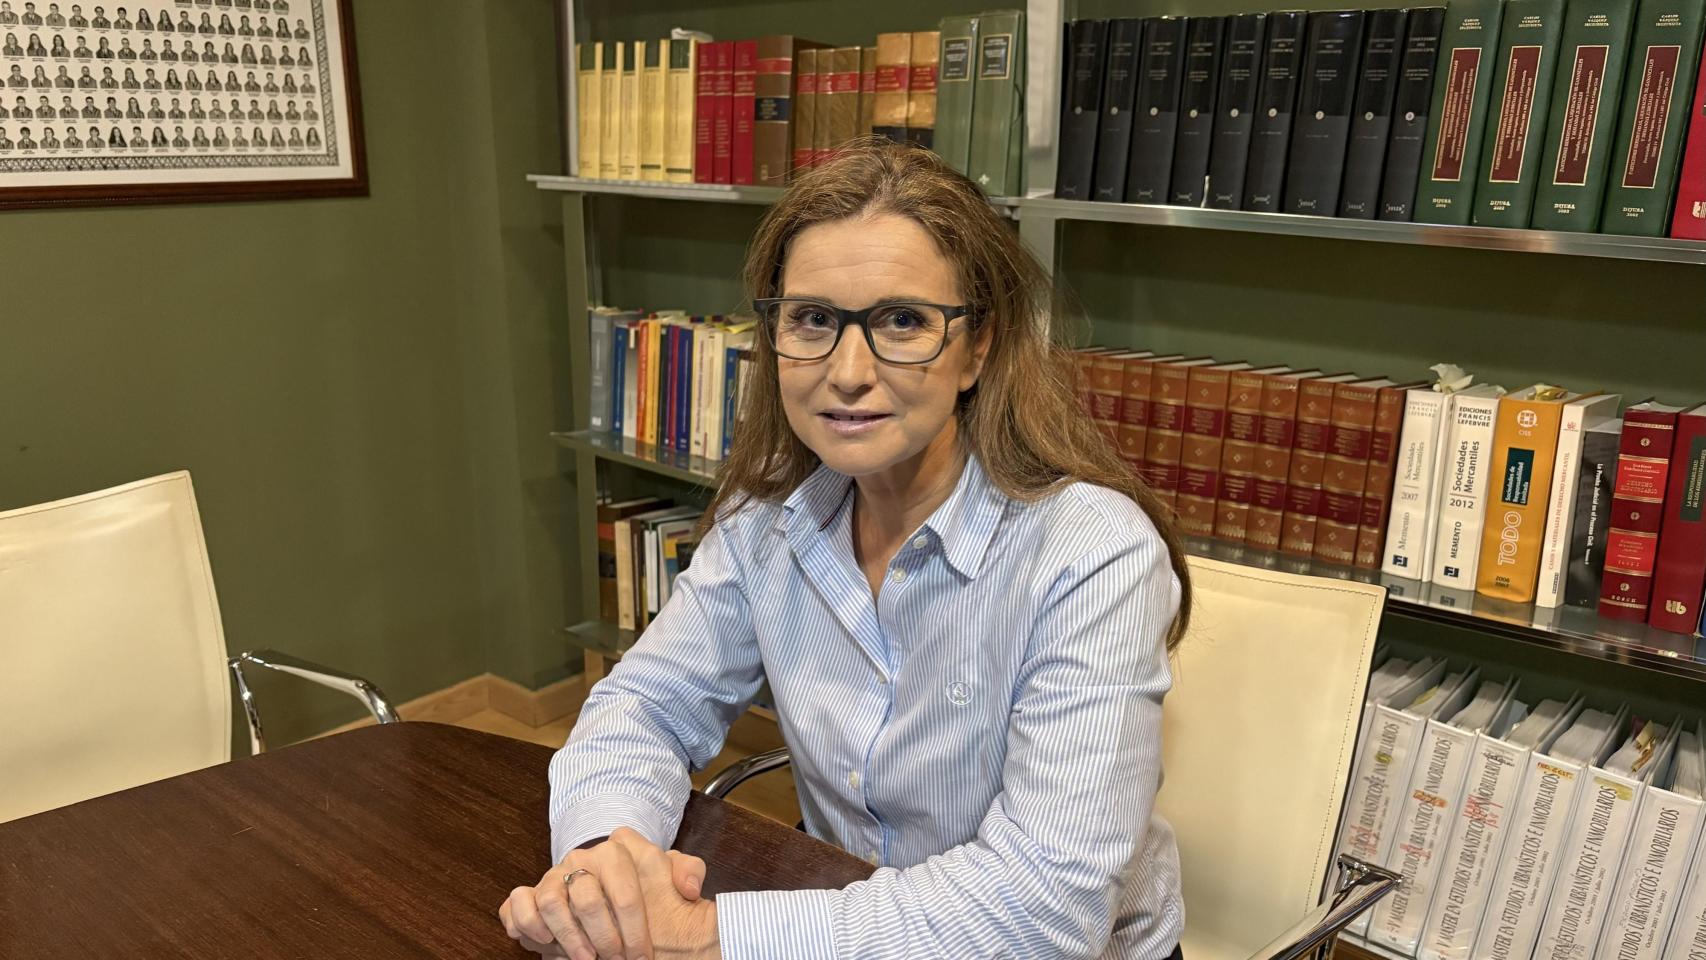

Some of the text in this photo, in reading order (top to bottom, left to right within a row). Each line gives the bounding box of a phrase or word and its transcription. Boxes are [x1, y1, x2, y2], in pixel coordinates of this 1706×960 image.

[1457, 419, 1490, 428] LEFEBVRE
[1458, 412, 1491, 421] FRANCIS
[1460, 406, 1492, 415] EDICIONES
[1406, 442, 1416, 480] Sociedades
[1453, 440, 1468, 492] Sociedades
[1464, 441, 1480, 492] Mercantiles
[1401, 492, 1418, 501] 2007
[1450, 500, 1474, 509] 2012
[1551, 516, 1560, 547] MATERIALES
[1556, 483, 1565, 507] DERECHO
[1398, 512, 1410, 550] Memento
[1451, 521, 1462, 558] MEMENTO
[1498, 511, 1522, 566] TODO
[1527, 769, 1560, 830] INMOBILIARIOS
[1584, 783, 1618, 846] INMOBILIARIOS
[1387, 893, 1408, 922] MASTER
[1422, 736, 1452, 793] INMOBILIARIOS
[1456, 813, 1487, 868] URBANÍSTICOS
[1509, 833, 1541, 889] URBANÍSTICOS
[1566, 849, 1599, 907] URBANÍSTICOS
[1625, 872, 1660, 930] URBANÍSTICOS
[1644, 805, 1680, 869] INMOBILIARIOS
[1447, 867, 1472, 904] ESTUDIOS
[1445, 903, 1462, 914] EN
[1500, 886, 1526, 924] ESTUDIOS
[1556, 904, 1583, 943] ESTUDIOS
[1437, 912, 1459, 941] MASTER
[1497, 922, 1515, 936] EN
